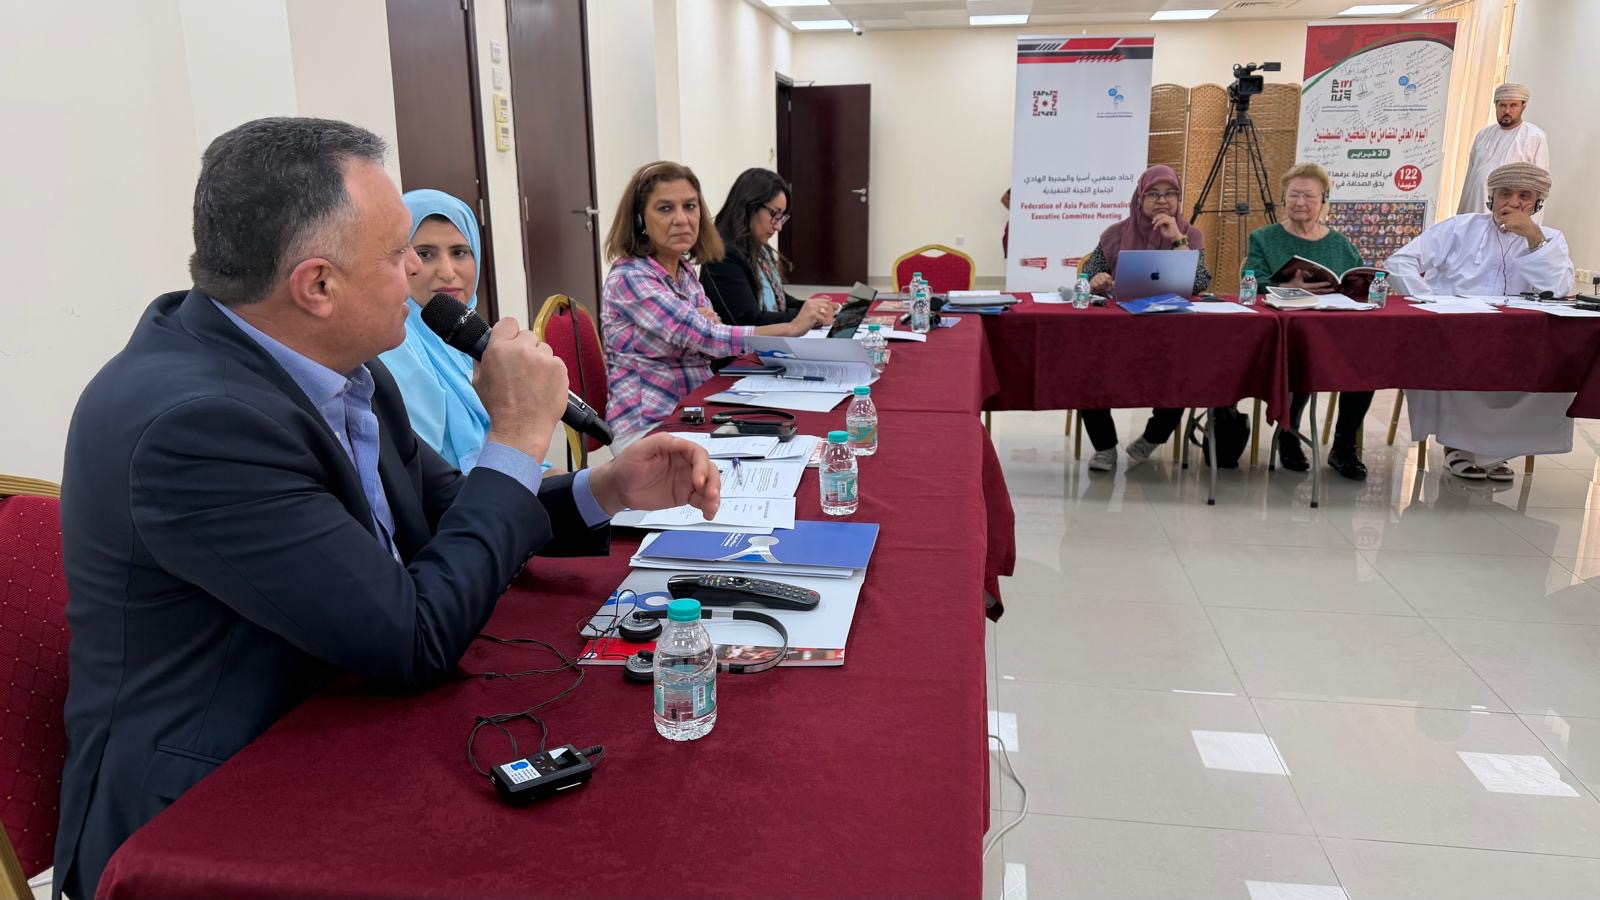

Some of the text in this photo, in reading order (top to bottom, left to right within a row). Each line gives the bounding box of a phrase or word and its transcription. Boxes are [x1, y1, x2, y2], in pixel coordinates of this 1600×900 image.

[1414, 127, 1428, 142] اليوم
[1350, 149, 1376, 159] فبراير
[1377, 149, 1388, 157] 26
[1048, 174, 1075, 184] والمحيط
[1351, 170, 1369, 179] مجزرة
[1383, 170, 1393, 180] في
[1400, 168, 1418, 180] 122
[1023, 174, 1047, 185] الهادي
[1372, 180, 1385, 189] بحق
[1072, 186, 1092, 194] اللجنة
[1335, 180, 1346, 190] في
[1020, 201, 1054, 210] Federation
[1055, 201, 1063, 209] of
[1064, 201, 1078, 209] Asia
[1079, 201, 1099, 209] Pacific
[1031, 211, 1122, 221] Executive Committee Meeting
